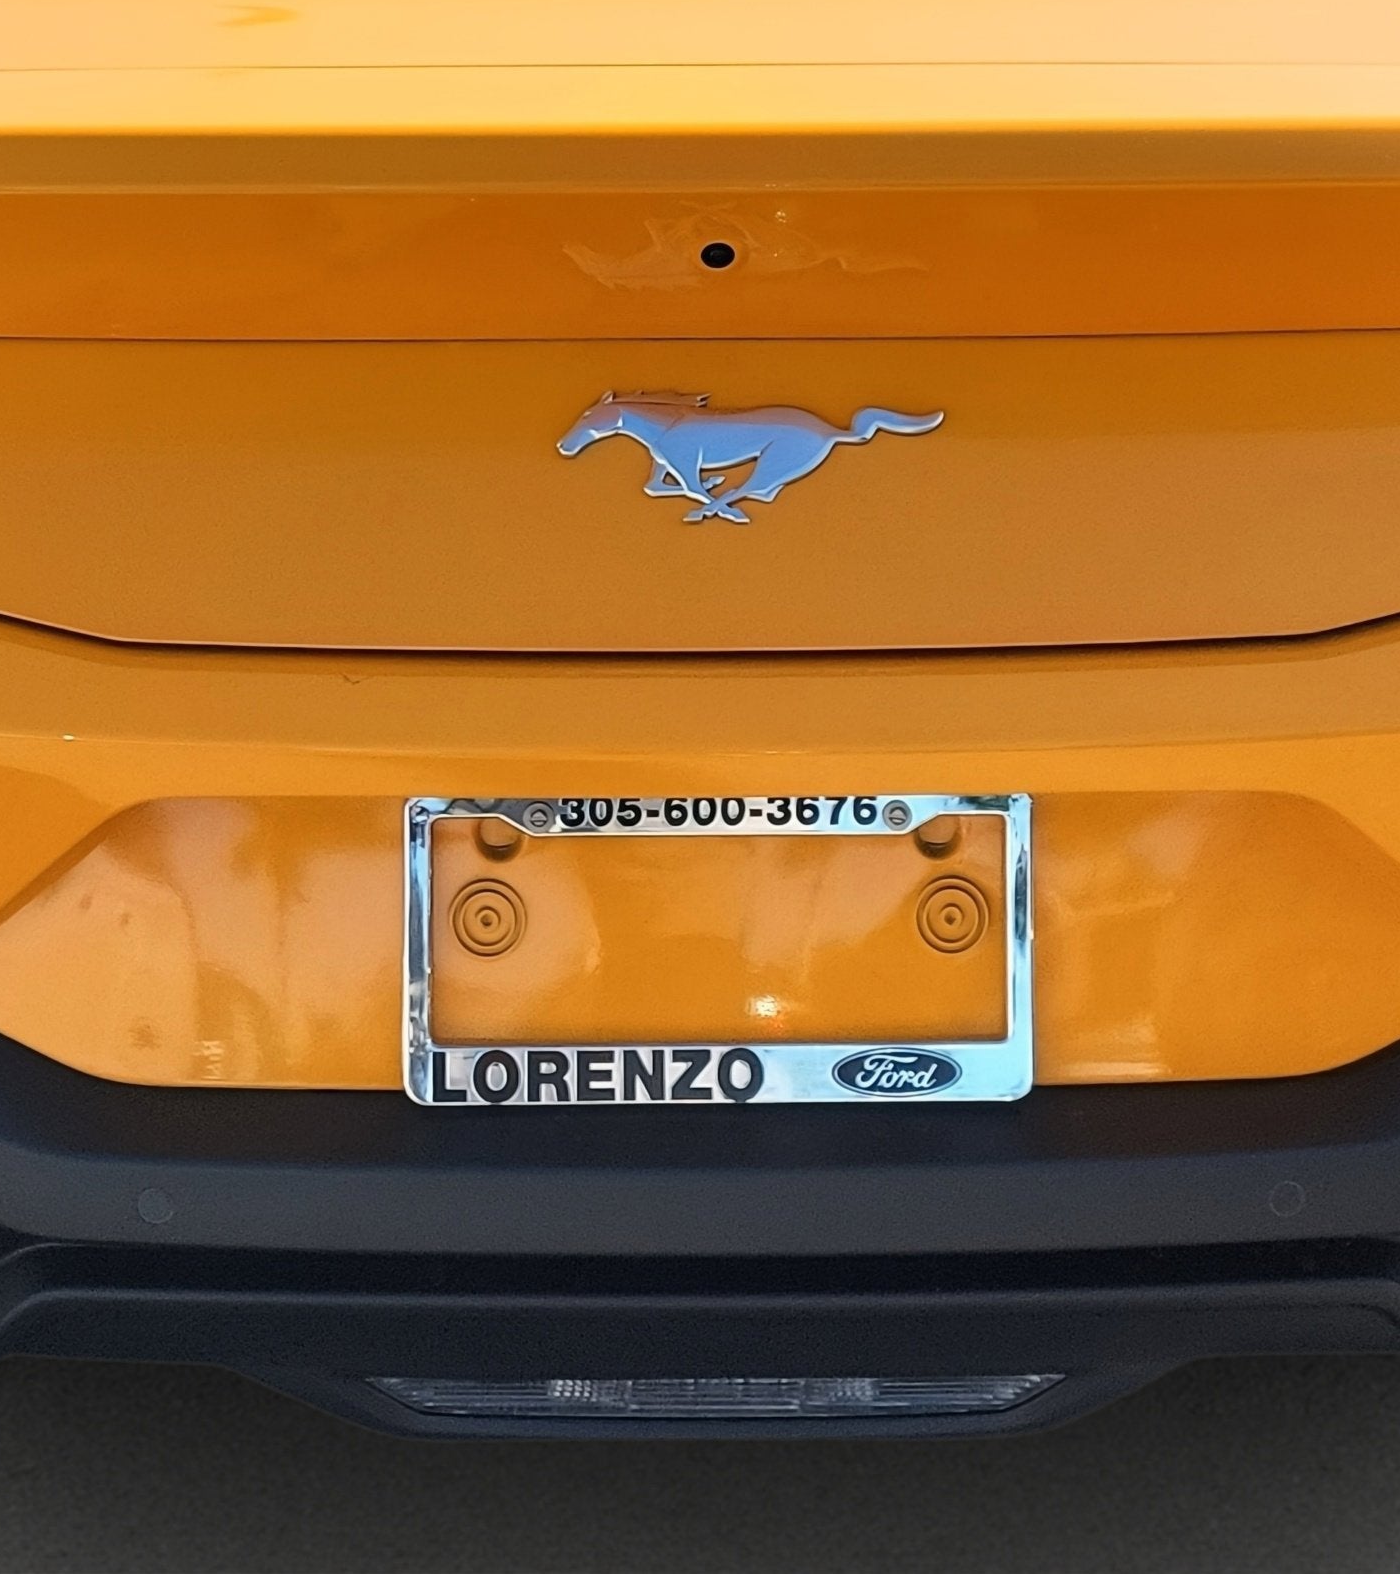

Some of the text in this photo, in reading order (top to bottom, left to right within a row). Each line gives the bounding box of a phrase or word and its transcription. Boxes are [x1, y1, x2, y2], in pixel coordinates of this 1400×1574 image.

[559, 796, 878, 828] 305-600-3676
[431, 1048, 939, 1103] LORENZO Ford
